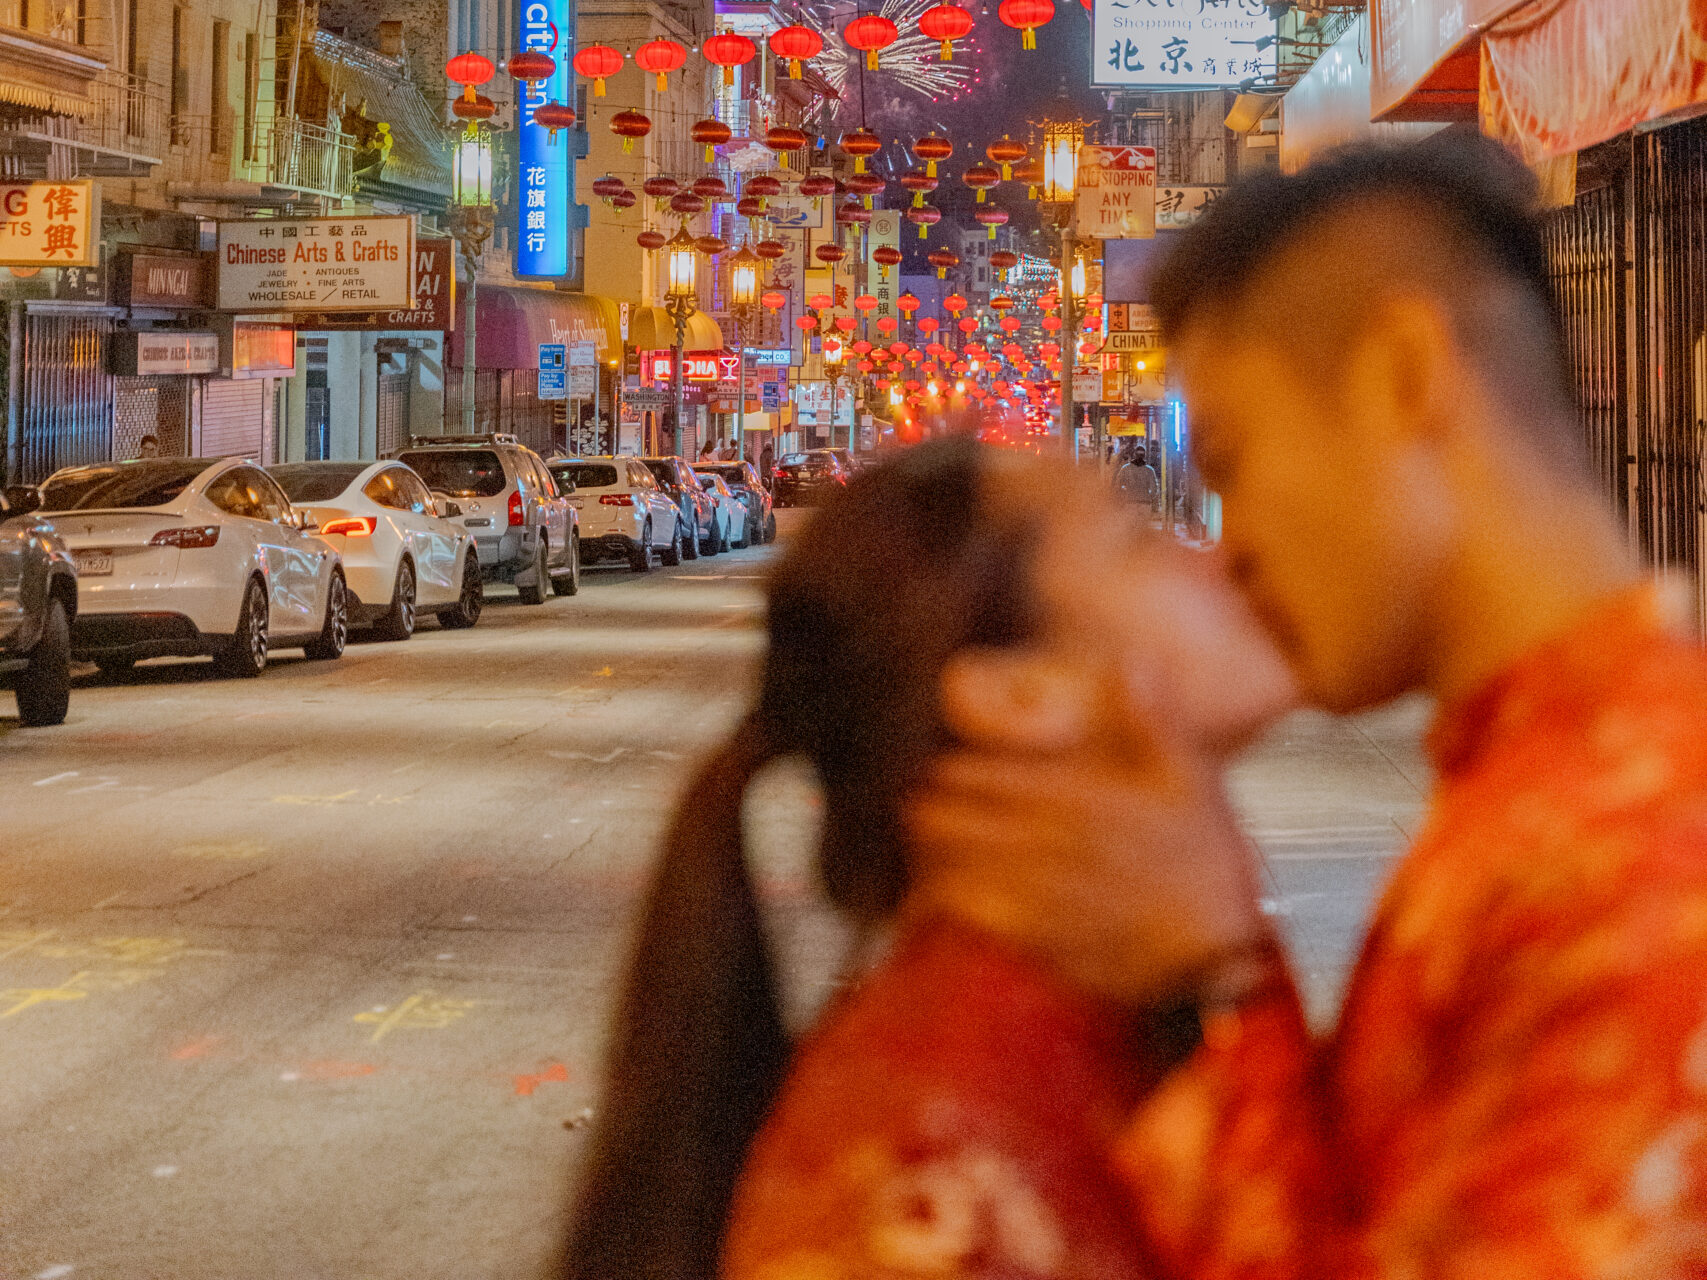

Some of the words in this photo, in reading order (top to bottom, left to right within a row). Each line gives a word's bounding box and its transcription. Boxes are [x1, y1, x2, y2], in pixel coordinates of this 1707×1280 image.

[1113, 17, 1192, 31] Shopping
[1201, 17, 1256, 30] Center
[1102, 172, 1153, 187] STOPPING
[1102, 192, 1131, 207] ANY
[526, 167, 546, 253] 花旗銀行
[260, 224, 367, 238] 中國工藝品
[227, 243, 286, 265] Chinese
[293, 241, 328, 263] Arts
[335, 241, 345, 262] &
[353, 239, 398, 262] Crafts
[267, 269, 287, 277] JADE
[316, 268, 359, 276] ANTIQUES
[258, 280, 298, 288] JEWELRY
[343, 278, 365, 286] ARTS
[248, 290, 316, 301] WHOLESALE
[342, 289, 380, 299] RETAIL
[388, 311, 435, 323] CRAFTS
[1112, 335, 1147, 348] CHINA
[624, 392, 670, 401] WASHINGTON
